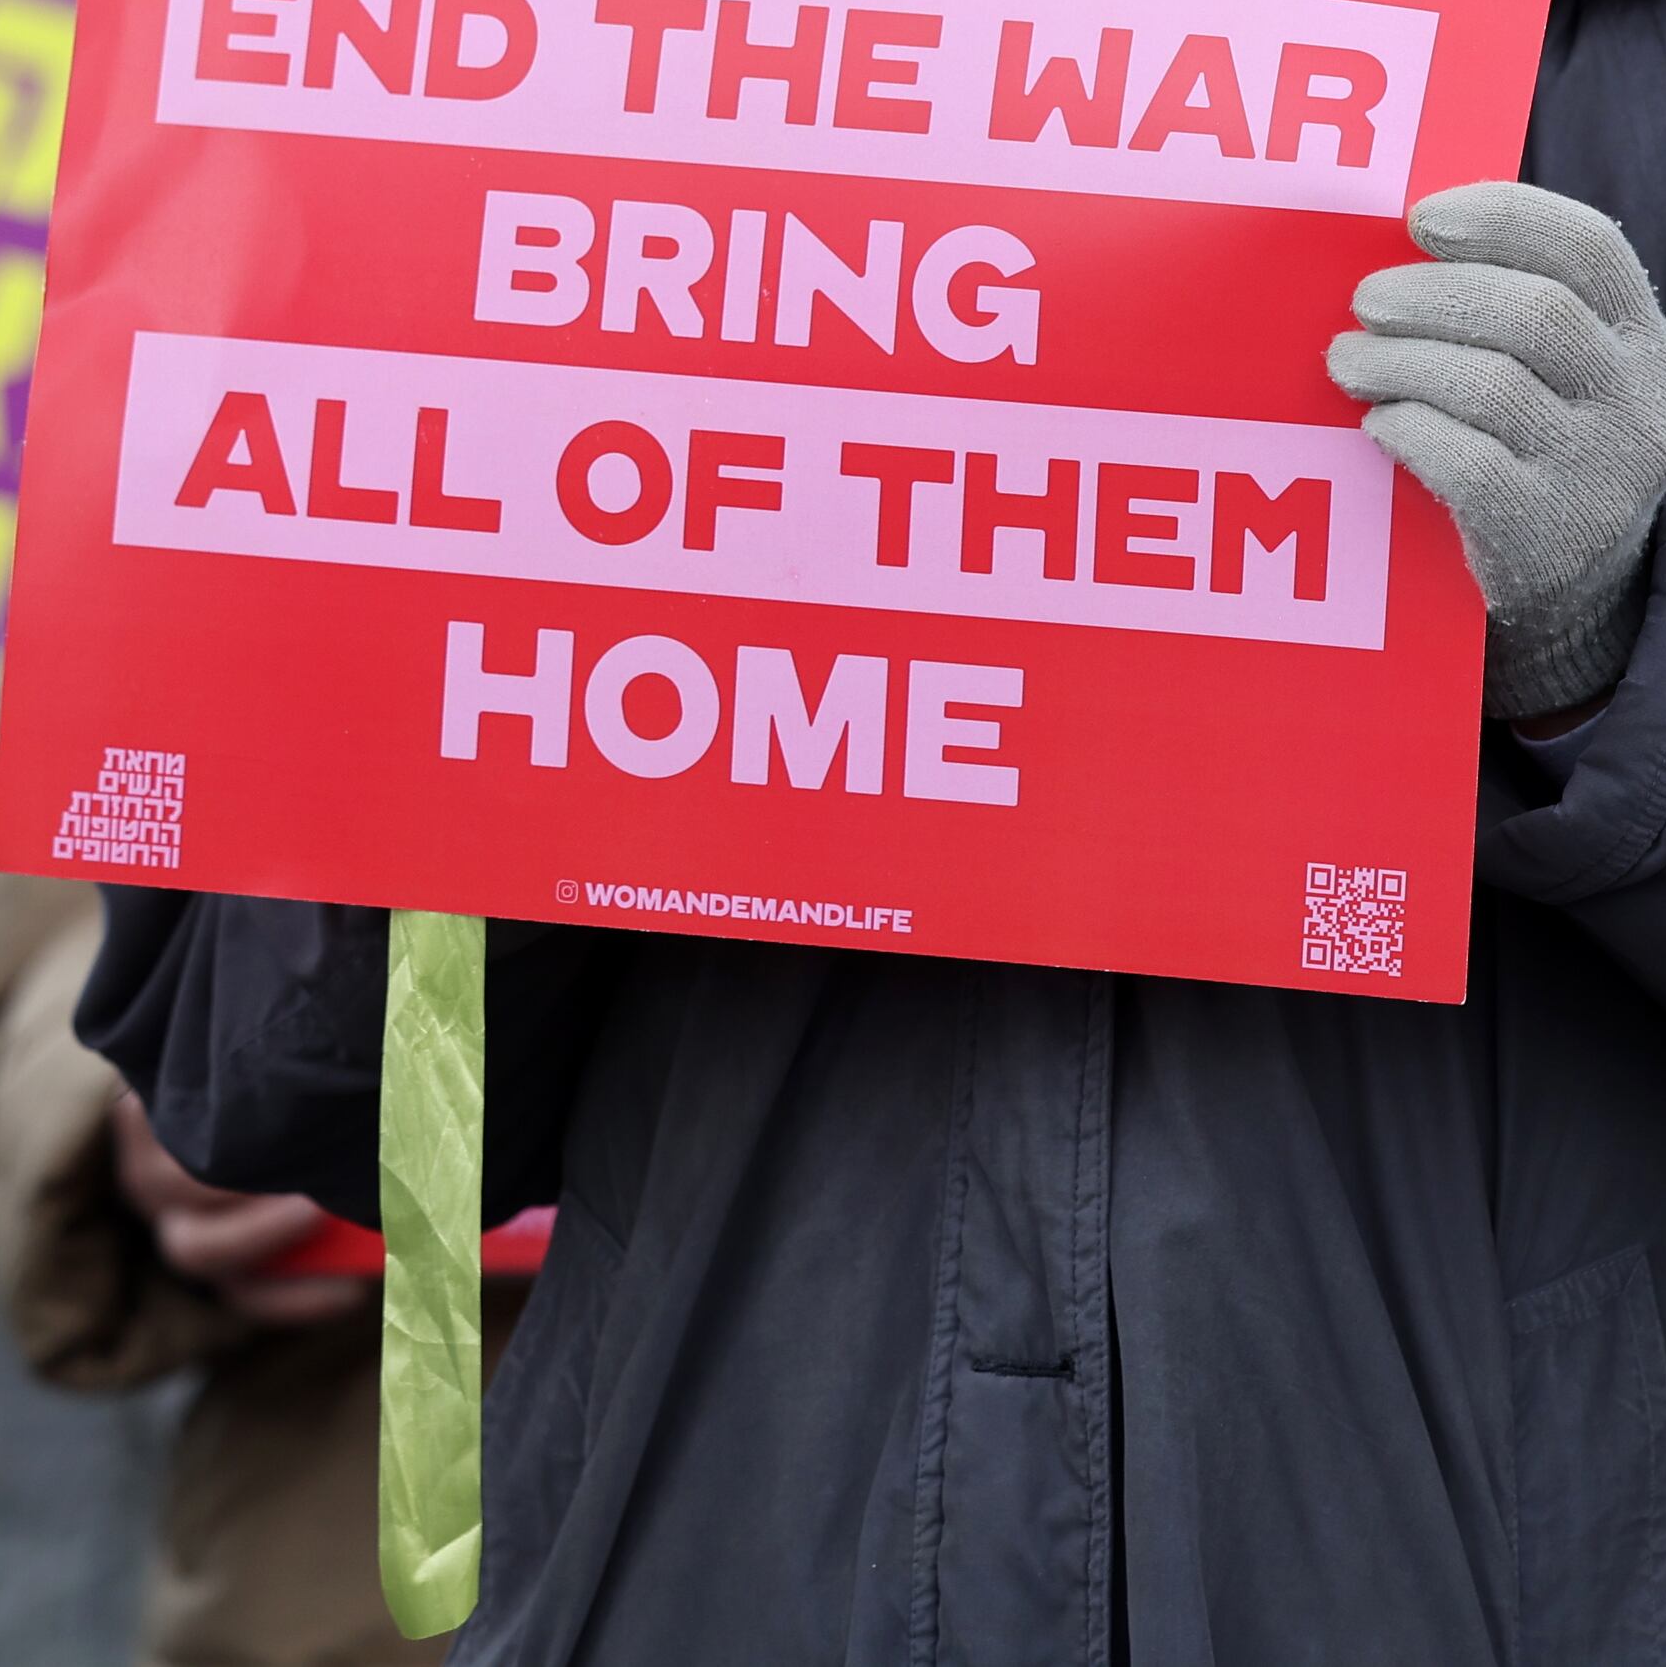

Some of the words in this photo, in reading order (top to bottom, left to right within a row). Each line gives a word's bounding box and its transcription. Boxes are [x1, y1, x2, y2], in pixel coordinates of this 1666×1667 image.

[986, 18, 1389, 170] WAR
[472, 190, 1040, 367] BRING
[172, 389, 504, 535] ALL
[554, 418, 787, 553] OF
[839, 441, 1331, 604] THEM
[439, 620, 1025, 808] HOME
[103, 746, 186, 776] מחאת
[97, 769, 185, 799] הנשים
[59, 810, 182, 845] החטופות
[69, 790, 183, 822] להחזרת
[51, 835, 181, 869] והחטופים
[585, 881, 913, 933] WOMANDEMANDLIFE
